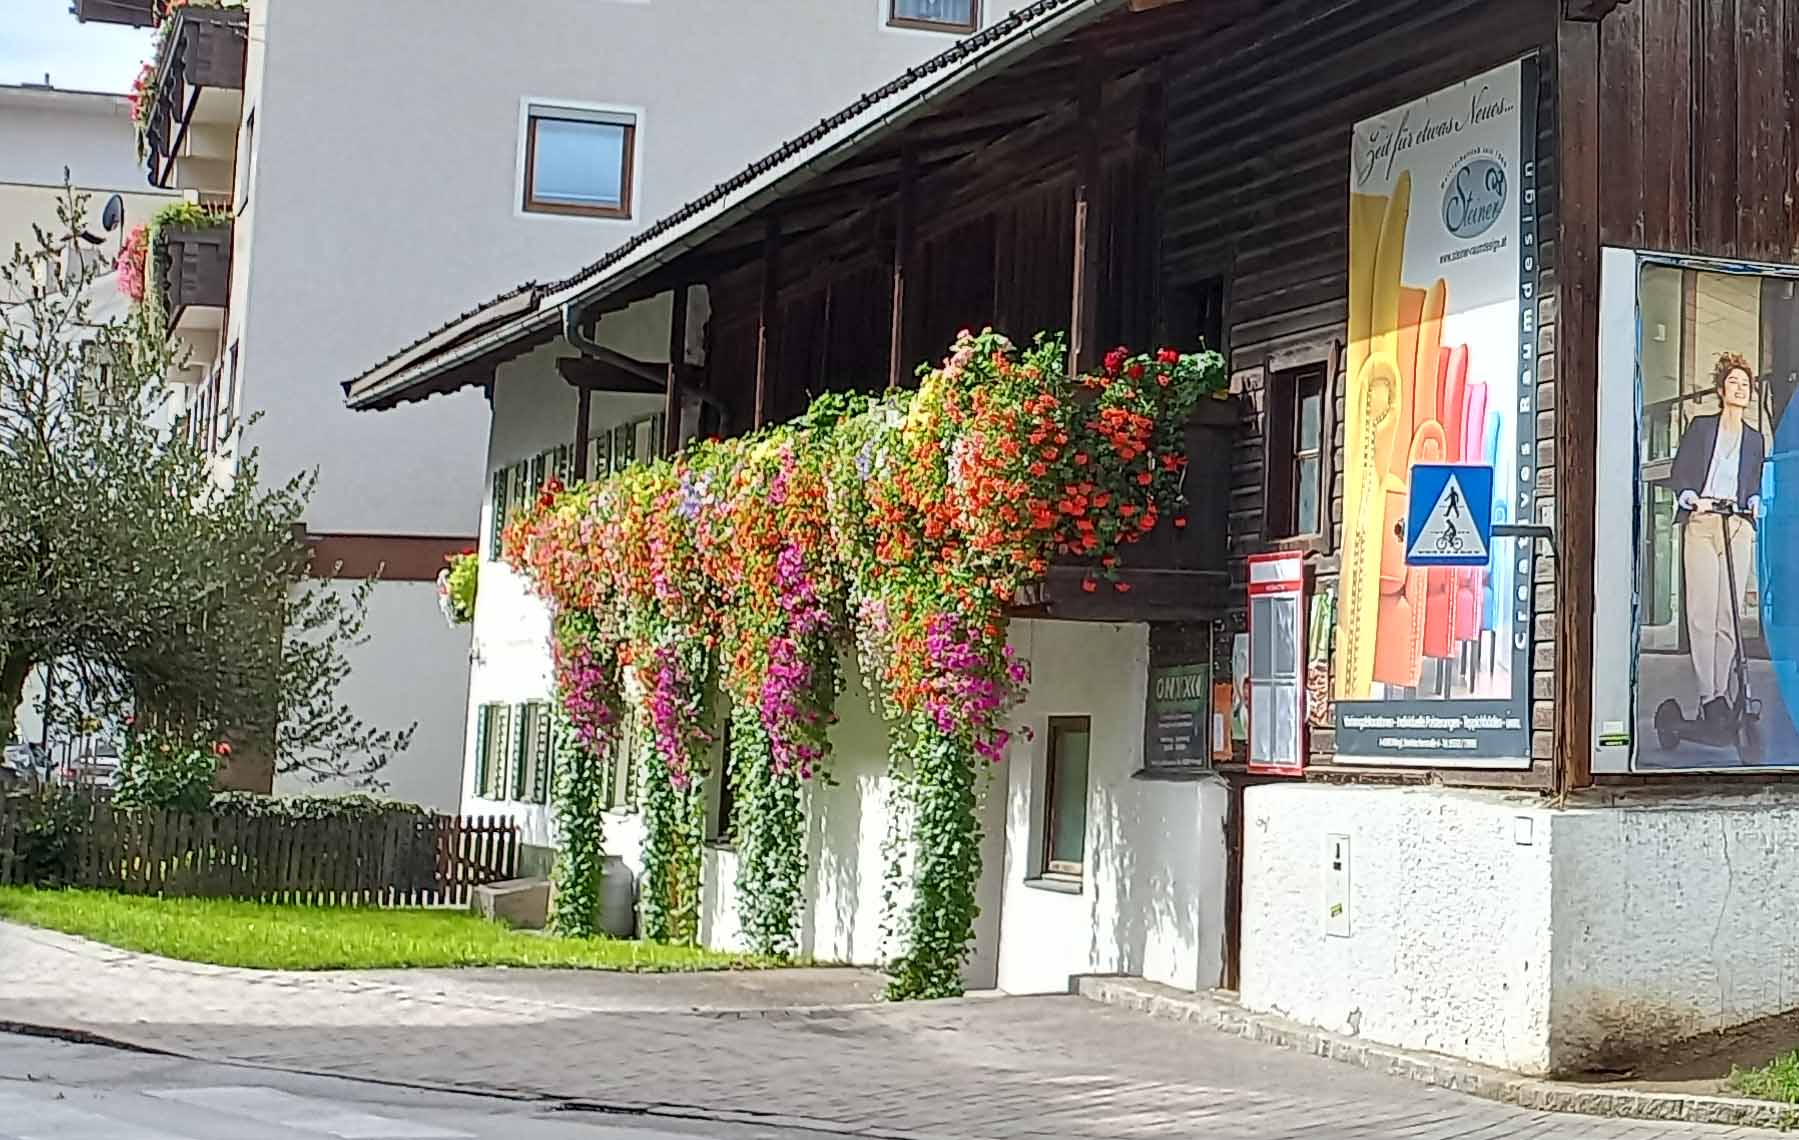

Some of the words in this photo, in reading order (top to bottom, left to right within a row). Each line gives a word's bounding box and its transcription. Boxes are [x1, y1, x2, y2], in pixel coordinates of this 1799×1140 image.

[1358, 130, 1394, 185] Zeit
[1385, 110, 1412, 181] für
[1415, 117, 1453, 145] etwas
[1446, 166, 1501, 232] Steiner
[1519, 161, 1536, 412] Raumdesign
[1514, 442, 1532, 649] Creatives
